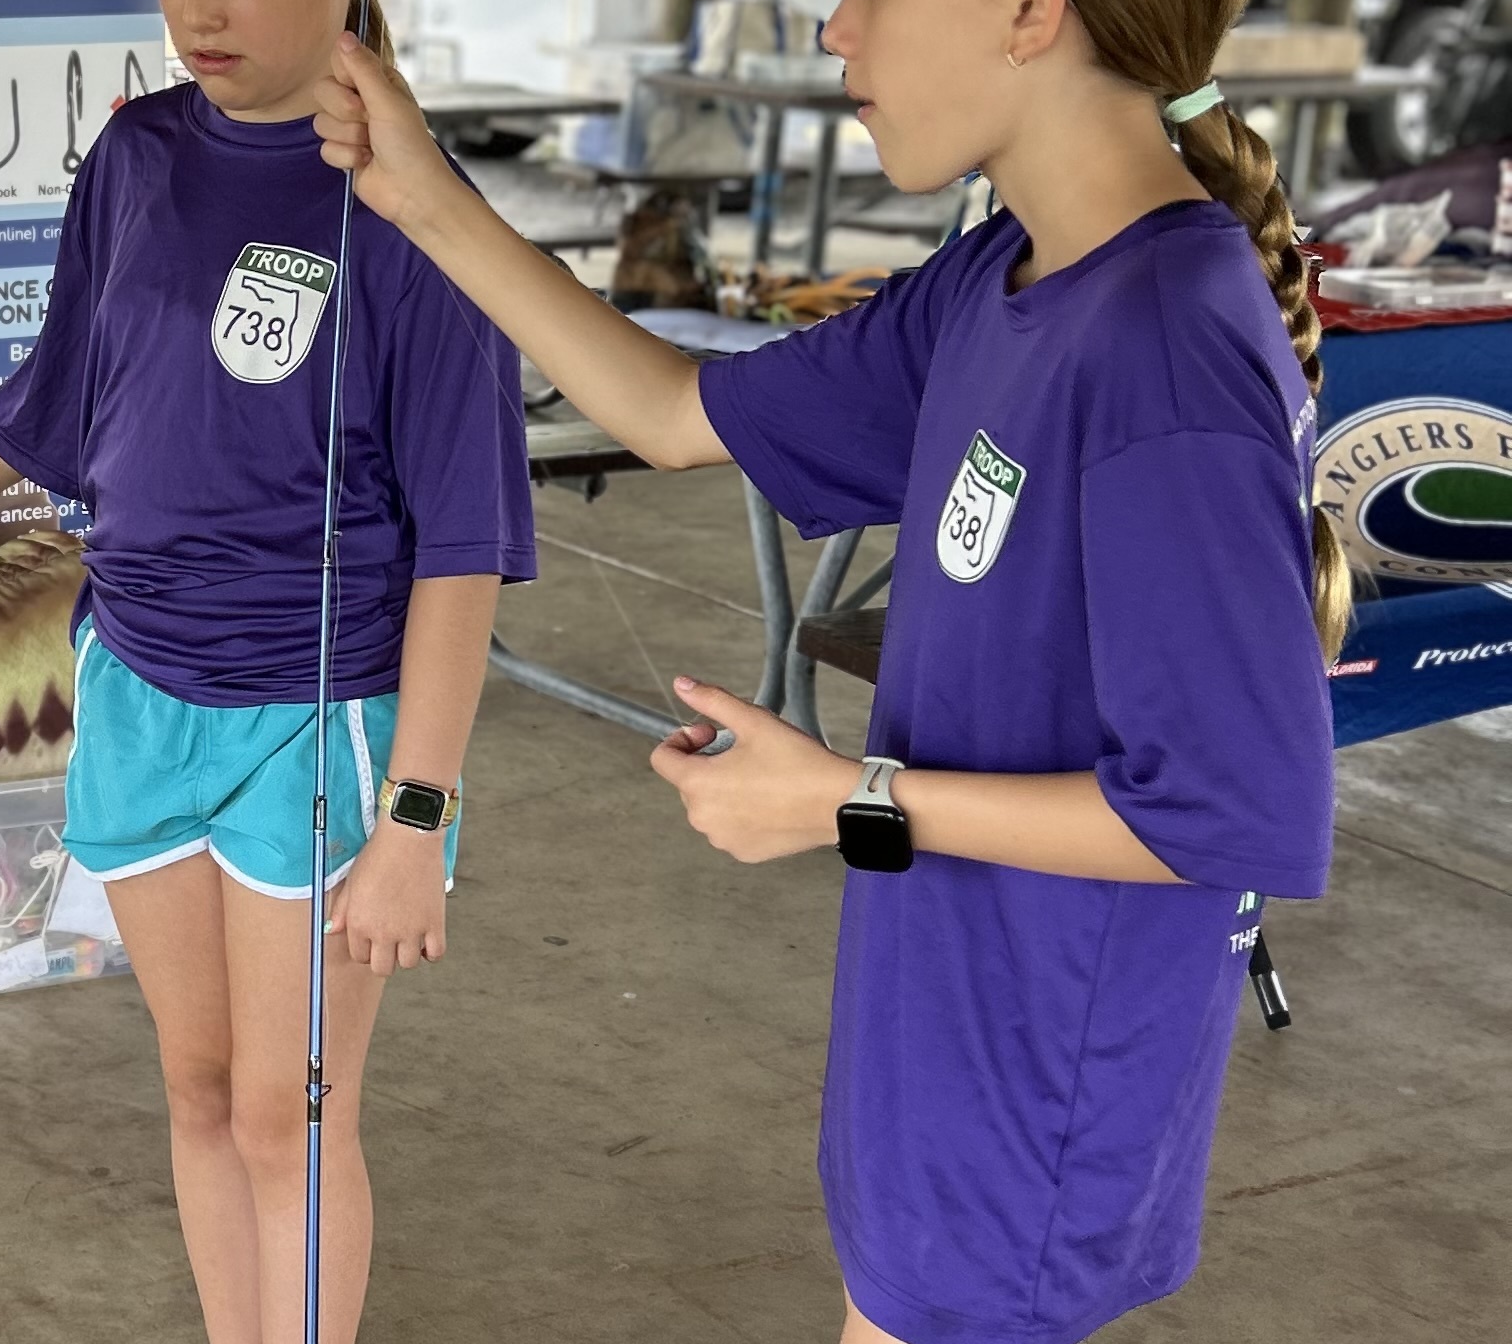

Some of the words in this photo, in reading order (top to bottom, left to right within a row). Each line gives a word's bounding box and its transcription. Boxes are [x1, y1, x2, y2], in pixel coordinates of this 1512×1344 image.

[248, 250, 324, 282] TROOP
[223, 305, 285, 351] 738
[972, 440, 1014, 486] TROOP
[1320, 421, 1474, 523] ANGLERS
[58, 499, 77, 517] of
[943, 495, 981, 550] 738
[1413, 640, 1512, 670] Protec
